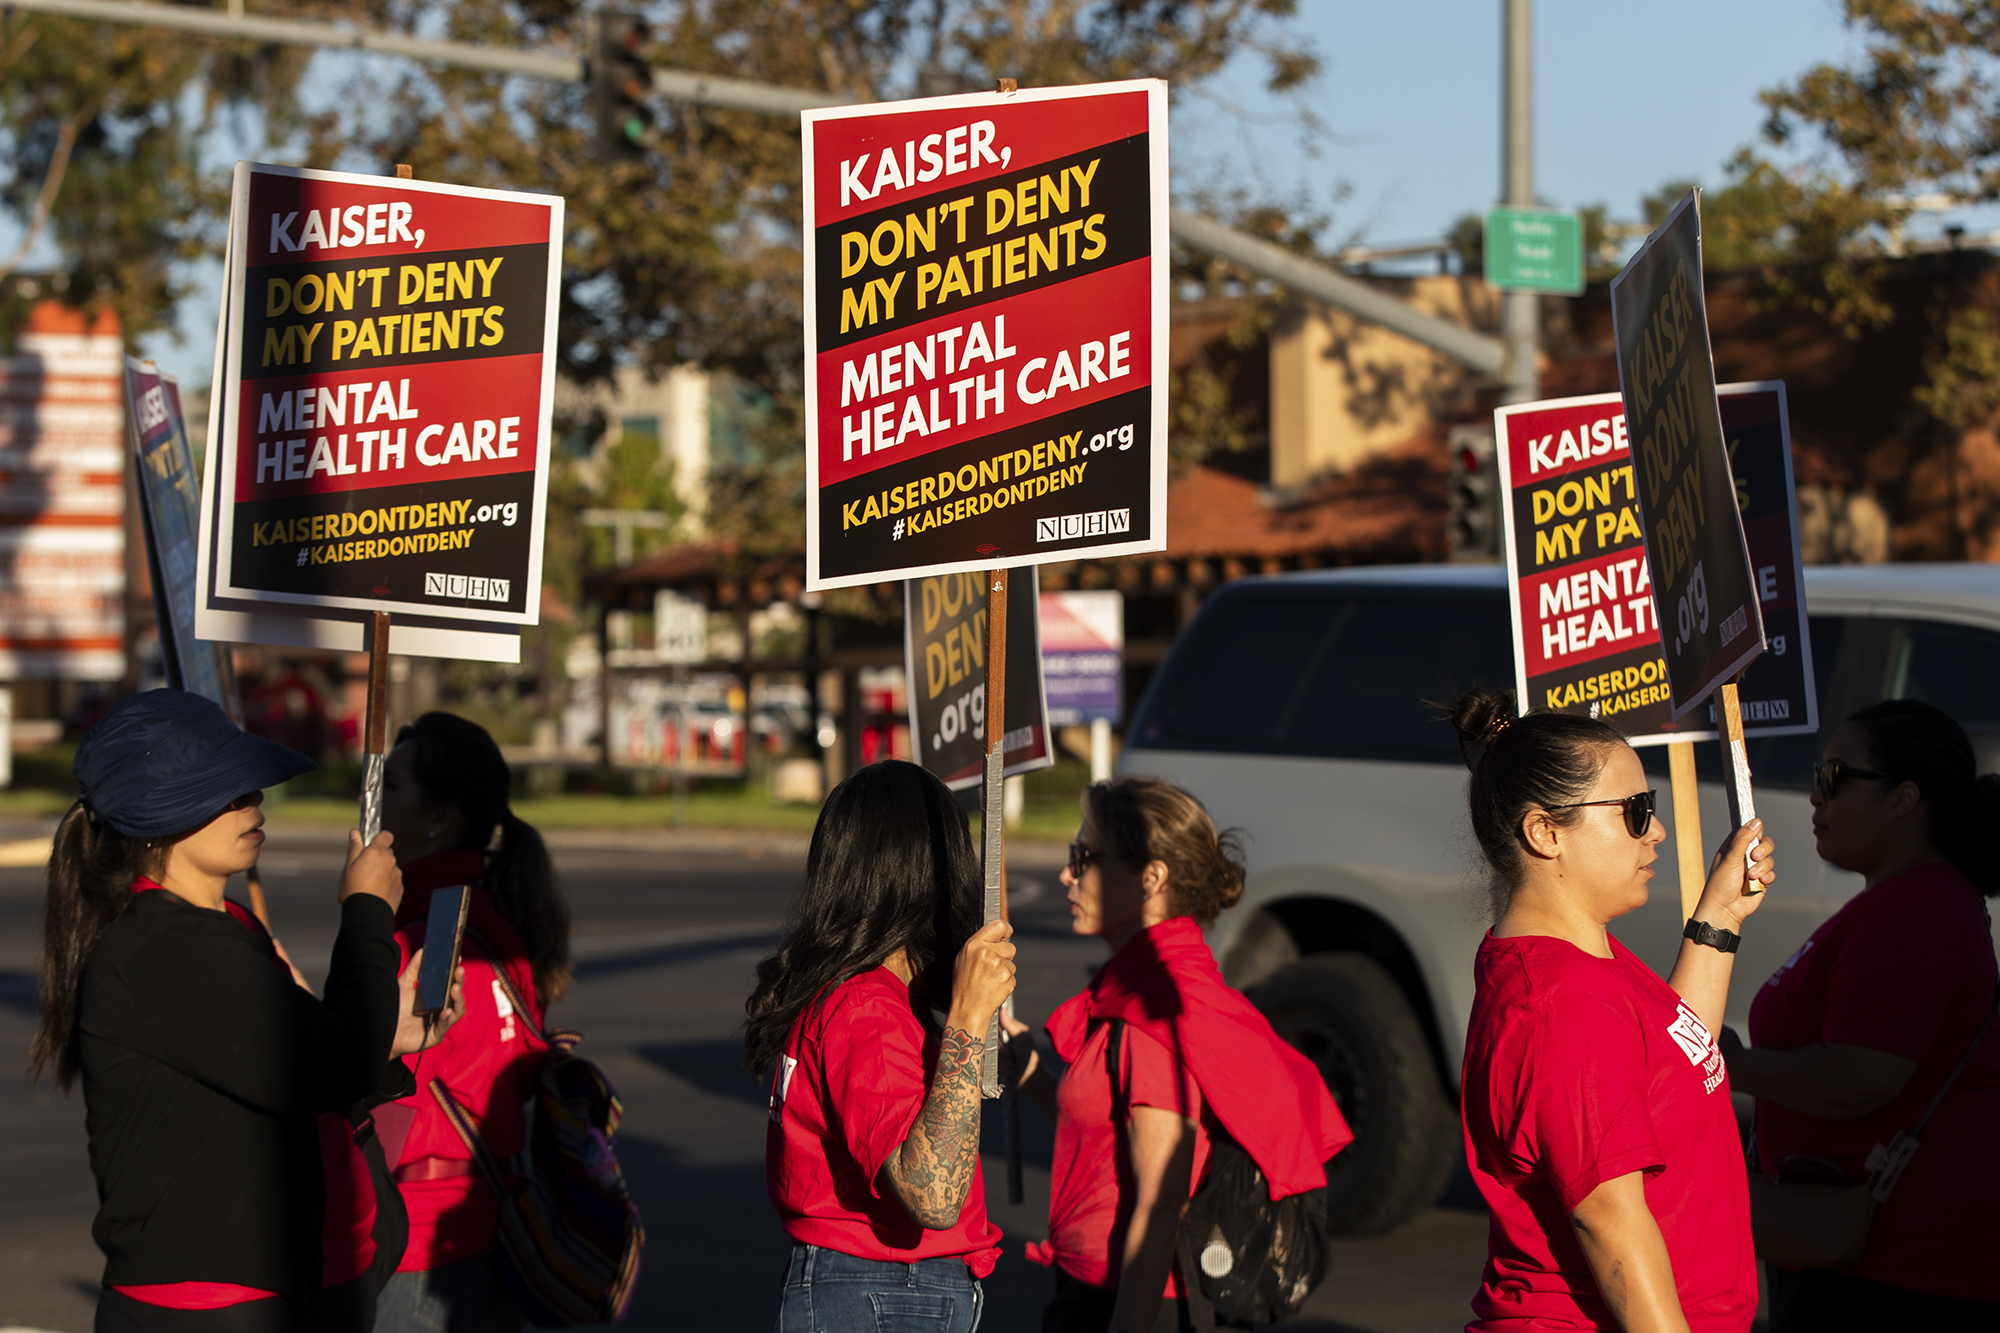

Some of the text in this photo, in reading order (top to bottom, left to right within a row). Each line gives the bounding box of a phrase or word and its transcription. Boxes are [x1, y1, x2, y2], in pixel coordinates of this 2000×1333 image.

[840, 120, 1012, 207] KAISER,
[269, 202, 425, 253] KAISER,
[841, 158, 1101, 279] DON'T DENY
[266, 257, 504, 317] DON'T DENY
[840, 213, 1107, 334] MY PATIENTS
[262, 305, 504, 367] MY PATIENTS
[840, 314, 1016, 408] MENTAL
[1630, 257, 1693, 427] KAISER
[257, 378, 418, 434] MENTAL
[842, 330, 1130, 462] HEALTH CARE
[256, 416, 520, 484] HEALTH CARE
[1528, 414, 1629, 474] KAISE
[1642, 358, 1696, 509] DONT
[842, 423, 1134, 531] KAISERDONTDENY.org
[892, 461, 1088, 542] #KAISERDONTDENY
[253, 499, 518, 547] KAISERDONTDENY.org
[296, 529, 475, 567] #KAISERDONTDENY
[1037, 509, 1130, 542] NUHW
[1536, 518, 1587, 566] MY
[1656, 448, 1706, 592] DENY
[425, 573, 510, 601] NUHW
[1675, 559, 1709, 657] .org
[925, 608, 986, 700] DEN
[1719, 605, 1748, 647] NUHW
[932, 682, 984, 751] .org
